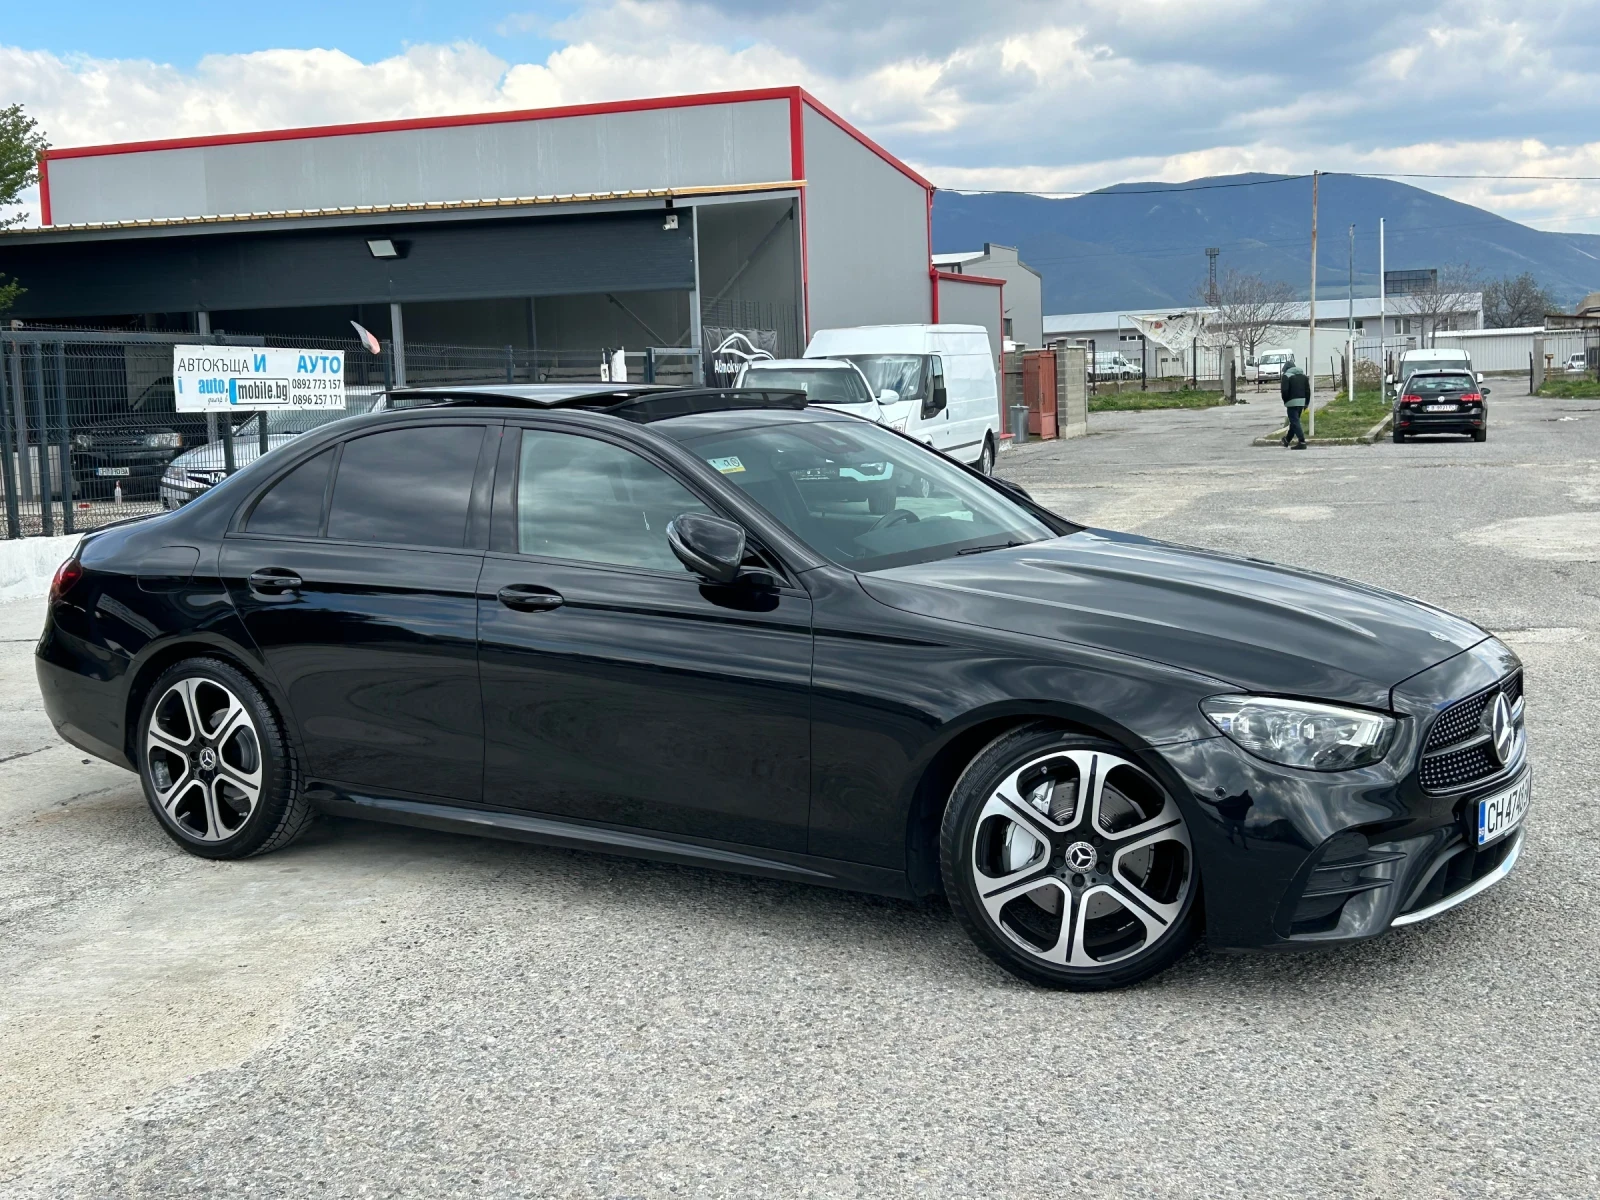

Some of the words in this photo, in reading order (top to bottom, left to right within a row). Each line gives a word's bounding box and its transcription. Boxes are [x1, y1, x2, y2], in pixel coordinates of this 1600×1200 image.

[177, 357, 250, 375] АВТОКЪЩА
[253, 353, 267, 373] И
[297, 354, 342, 374] АУТО
[237, 380, 289, 402] mobile.bg
[292, 378, 312, 390] 0892
[313, 379, 327, 390] 773
[328, 379, 342, 390] 157
[292, 394, 313, 405] 0896
[313, 395, 328, 405] 257
[329, 395, 343, 405] 171
[1487, 797, 1505, 834] CH
